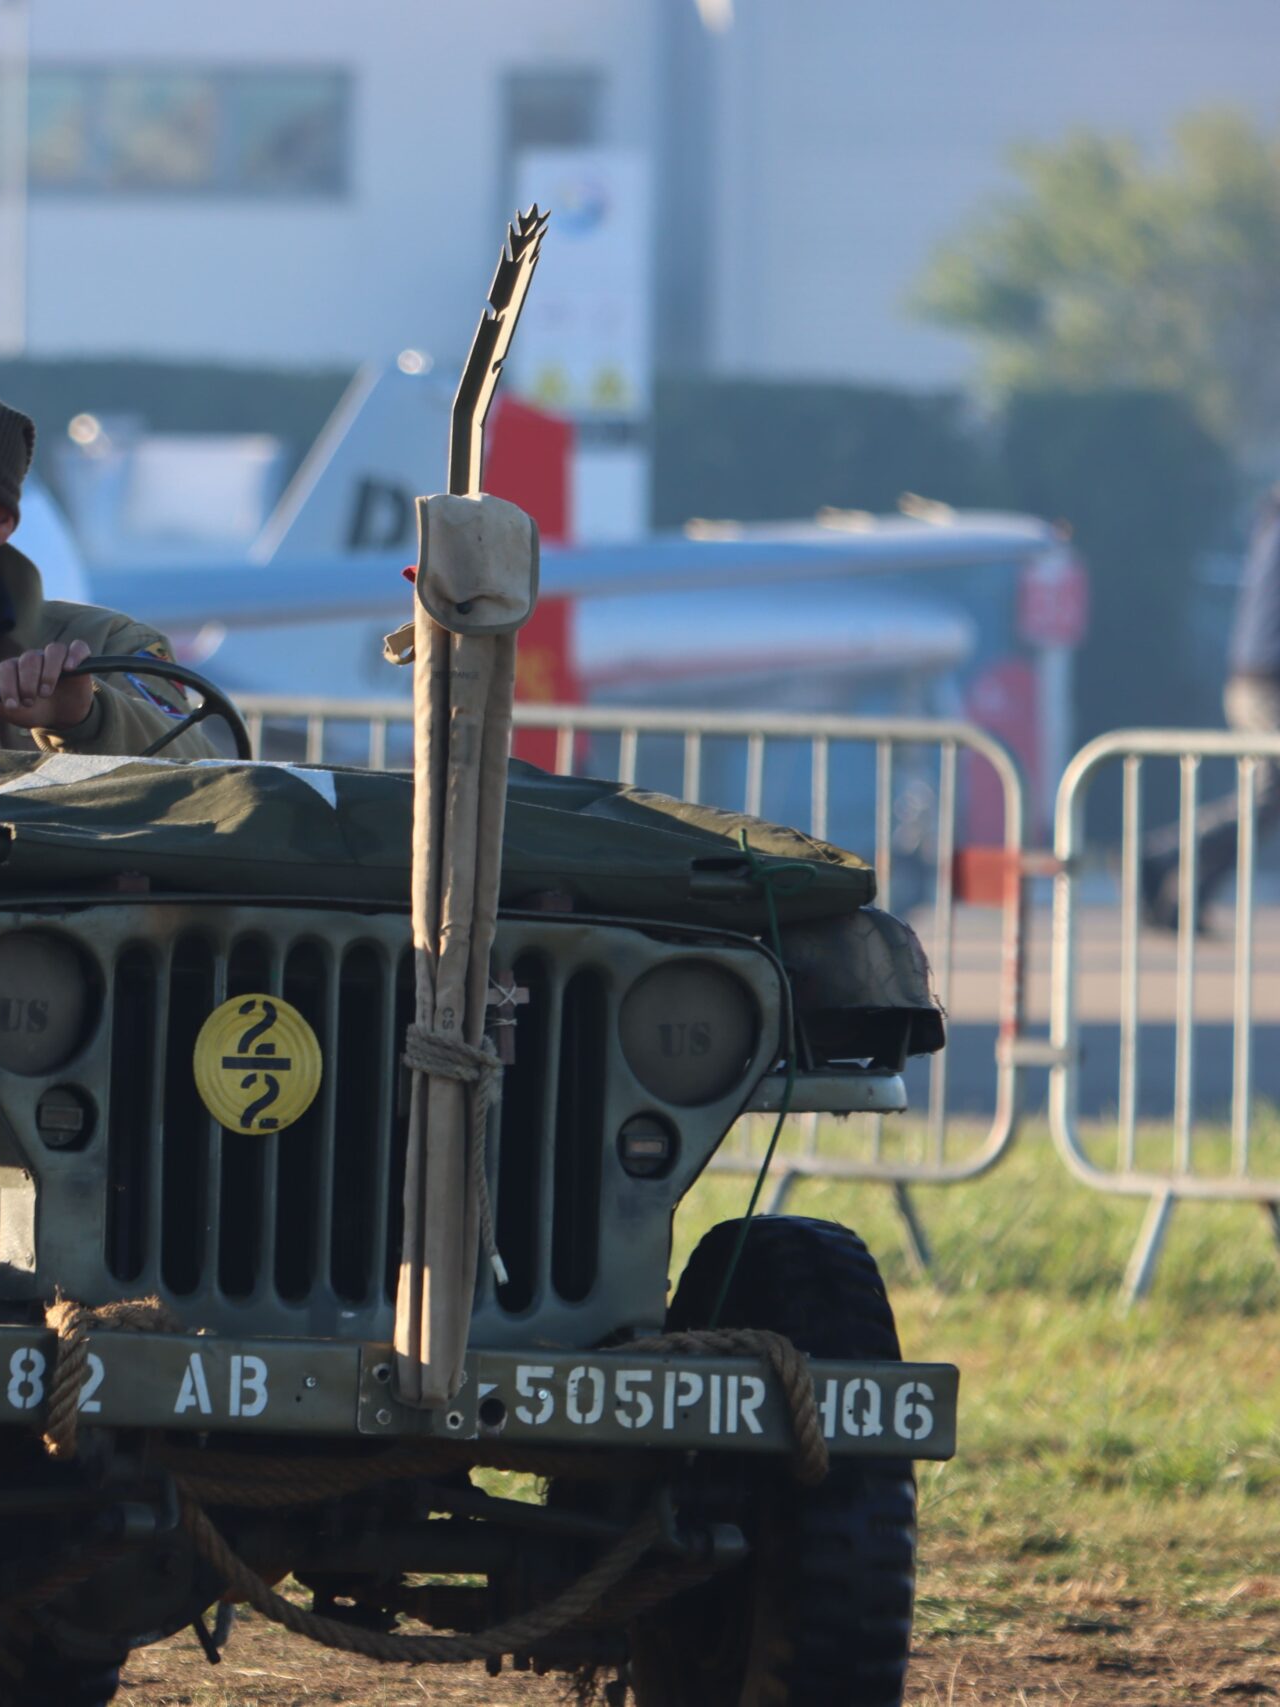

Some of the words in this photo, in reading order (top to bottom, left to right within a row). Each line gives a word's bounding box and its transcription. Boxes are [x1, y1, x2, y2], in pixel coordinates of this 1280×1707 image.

[0, 998, 49, 1033] US
[657, 1021, 711, 1058] US
[174, 1353, 269, 1417] AB
